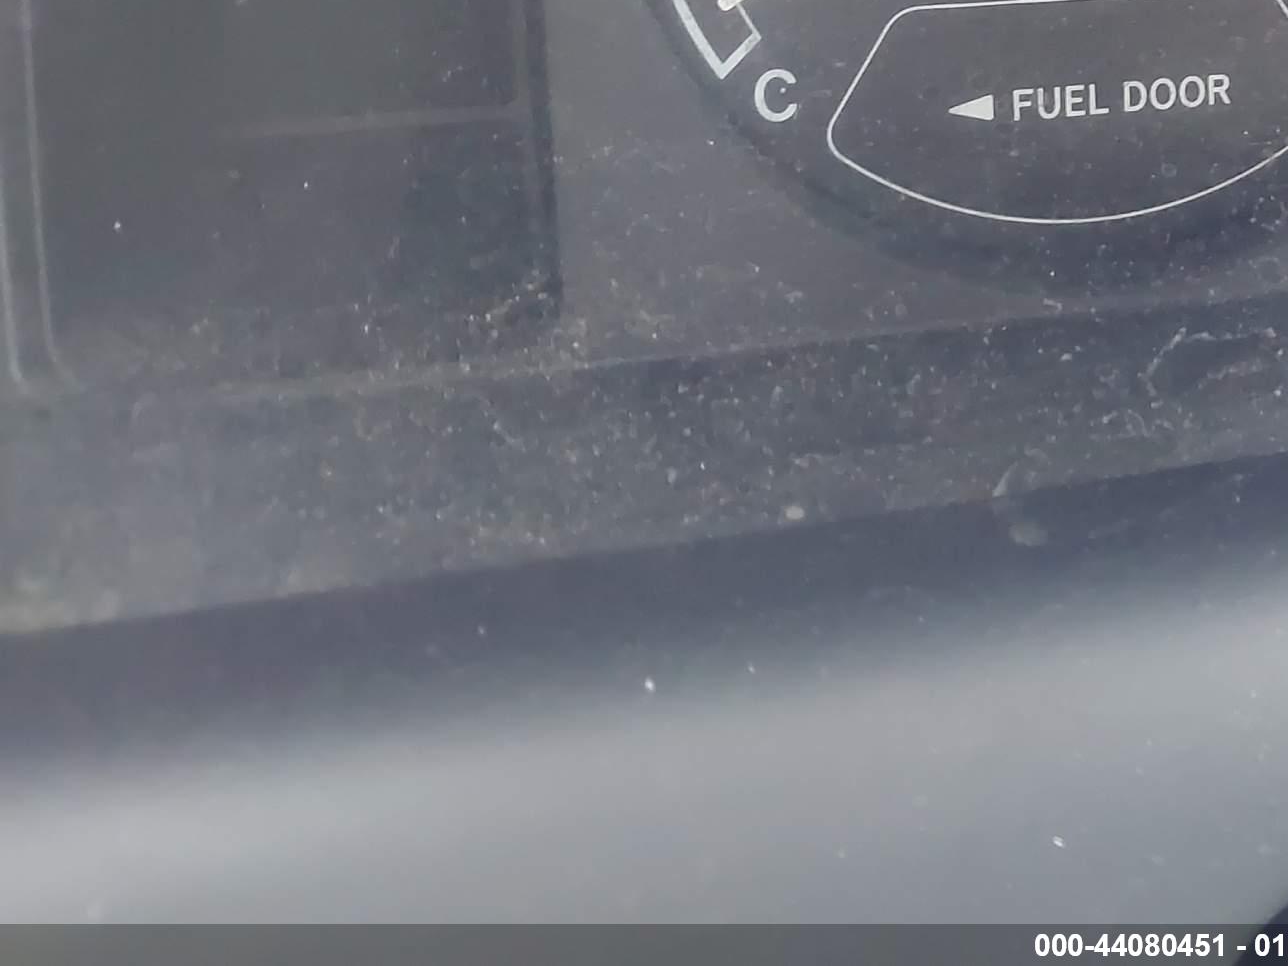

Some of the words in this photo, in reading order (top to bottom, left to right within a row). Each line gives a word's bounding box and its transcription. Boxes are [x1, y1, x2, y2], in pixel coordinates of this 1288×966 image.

[754, 68, 798, 123] C
[1012, 85, 1110, 122] FUEL
[1123, 74, 1231, 112] DOOR
